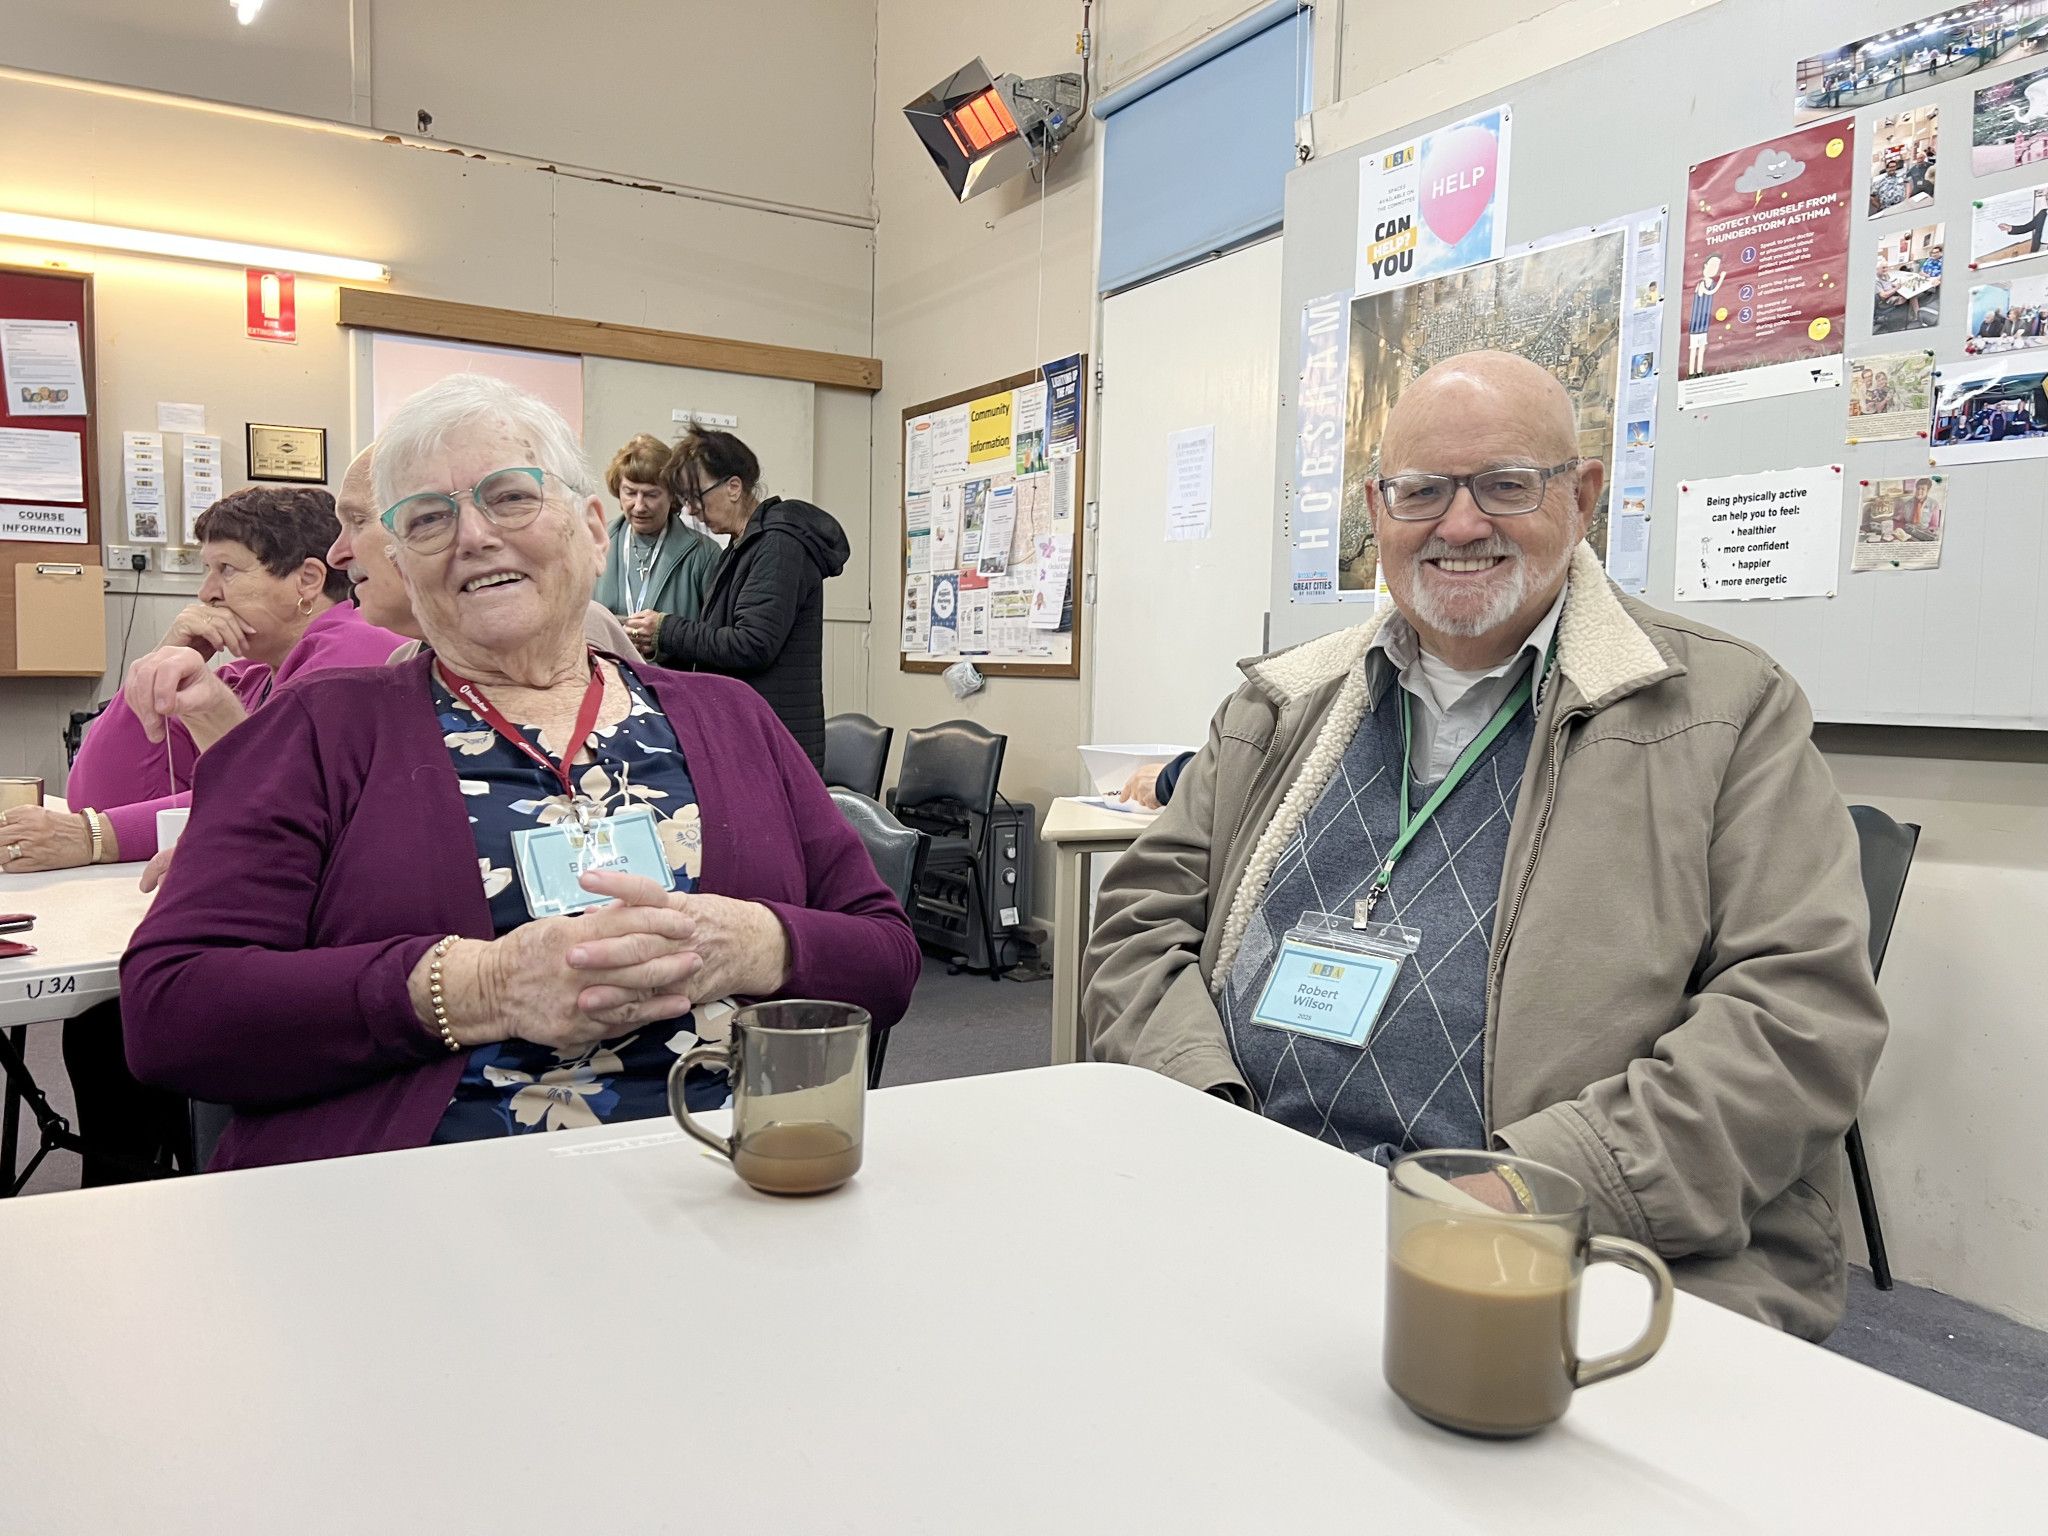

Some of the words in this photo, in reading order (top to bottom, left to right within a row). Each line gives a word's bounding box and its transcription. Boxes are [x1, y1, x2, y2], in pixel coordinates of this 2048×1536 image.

[1432, 166, 1485, 200] HELP
[1705, 215, 1751, 236] PROTECT
[1752, 201, 1806, 222] YOURSELF
[1805, 192, 1838, 209] FROM
[1375, 214, 1411, 243] CAN
[1705, 218, 1786, 246] THUNDERSTORM
[1787, 206, 1831, 225] ASTHMA
[1373, 233, 1412, 259] HELP?
[1372, 248, 1414, 280] YOU
[970, 402, 1010, 422] Community
[1299, 300, 1341, 550] HORSHAM
[970, 435, 1010, 453] information
[1706, 497, 1730, 507] Being
[1732, 490, 1777, 505] physically
[1779, 488, 1807, 499] active
[18, 511, 65, 522] COURSE
[1711, 513, 1727, 522] can
[1729, 510, 1748, 522] help
[1749, 510, 1766, 522] you
[1768, 508, 1778, 517] to
[1780, 505, 1800, 516] feel:
[2, 523, 82, 536] INFORMATION
[1737, 524, 1777, 536] healthier
[1723, 544, 1745, 554] more
[1747, 540, 1790, 552] confident
[1738, 559, 1771, 571] happier
[1293, 582, 1312, 591] GREAT
[1313, 581, 1332, 590] CITIES
[1721, 577, 1743, 587] more
[1745, 574, 1788, 588] energetic
[26, 975, 76, 999] U3A
[1297, 983, 1339, 1000] Robert
[1293, 995, 1333, 1012] Wilson
